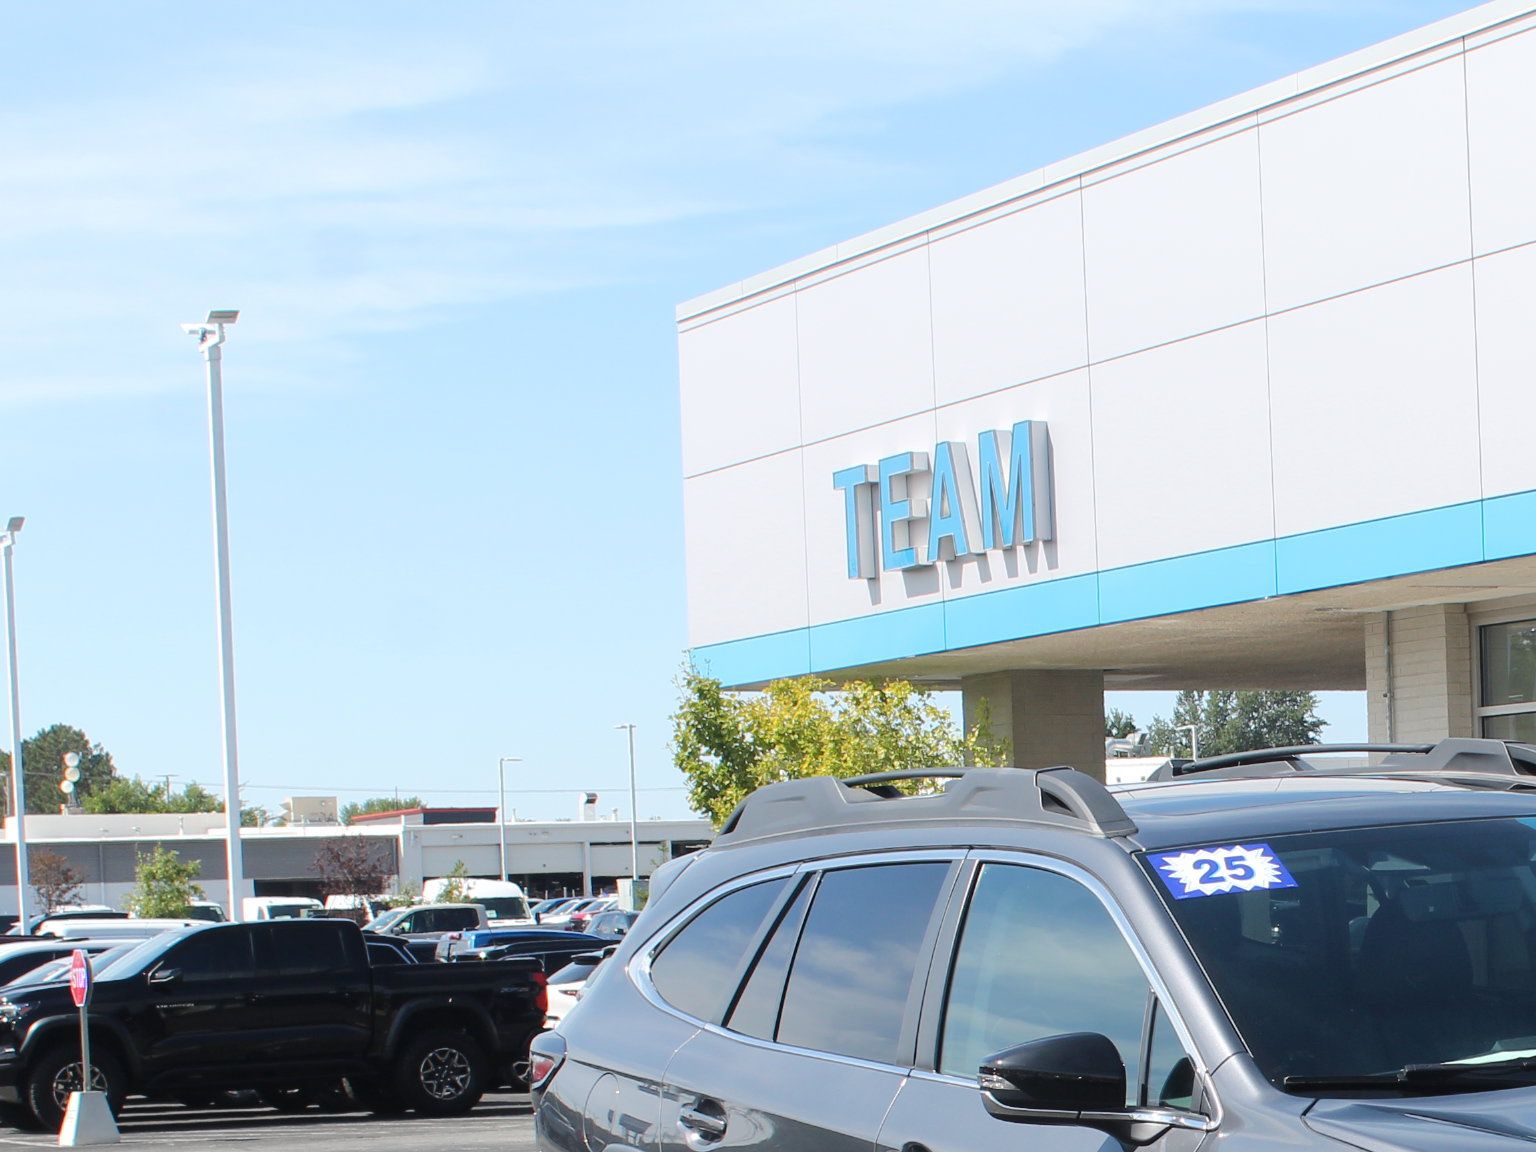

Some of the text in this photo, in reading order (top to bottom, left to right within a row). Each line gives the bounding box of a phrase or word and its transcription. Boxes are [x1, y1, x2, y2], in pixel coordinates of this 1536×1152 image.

[832, 420, 1051, 579] TEAM
[1192, 855, 1255, 885] 25
[71, 967, 87, 988] STOP
